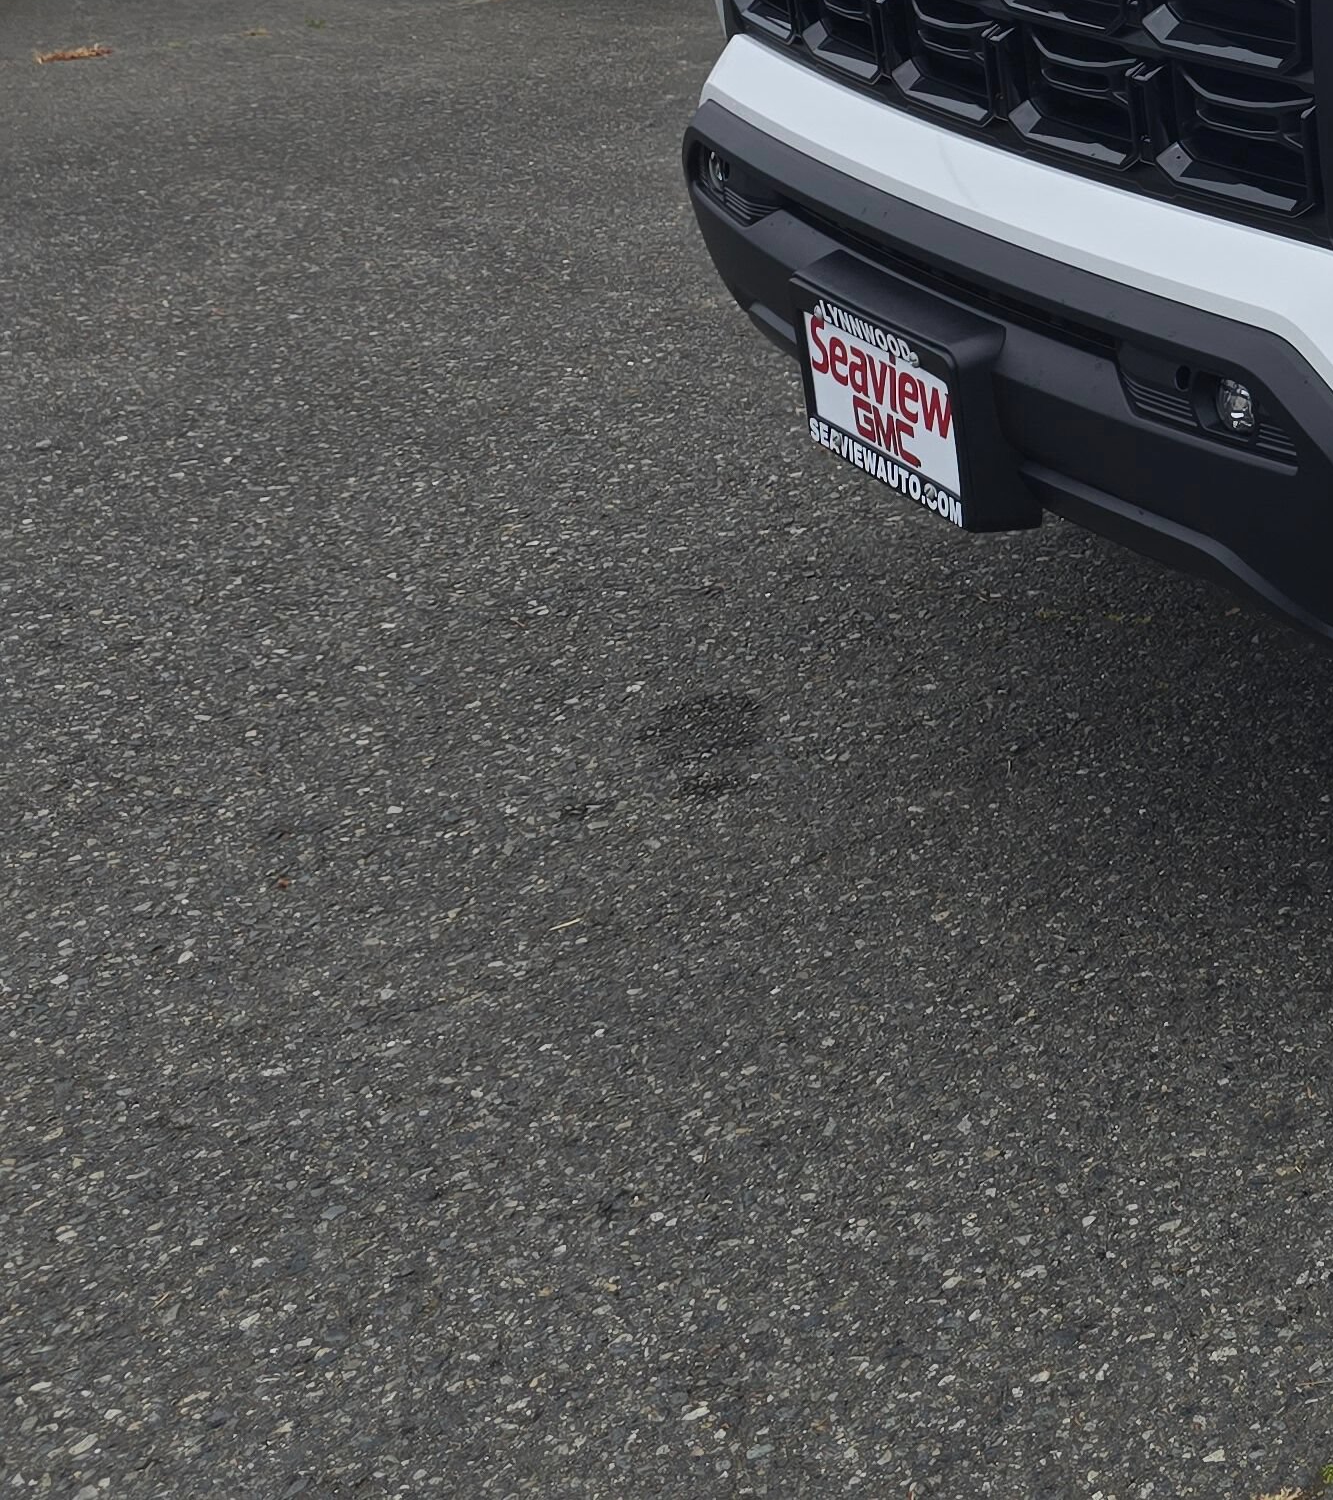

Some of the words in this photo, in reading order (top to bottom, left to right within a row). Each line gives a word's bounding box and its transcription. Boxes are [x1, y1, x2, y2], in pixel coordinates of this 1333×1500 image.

[818, 299, 914, 362] LYNNWOOD
[810, 311, 954, 440] Seaview
[852, 394, 922, 469] GMC
